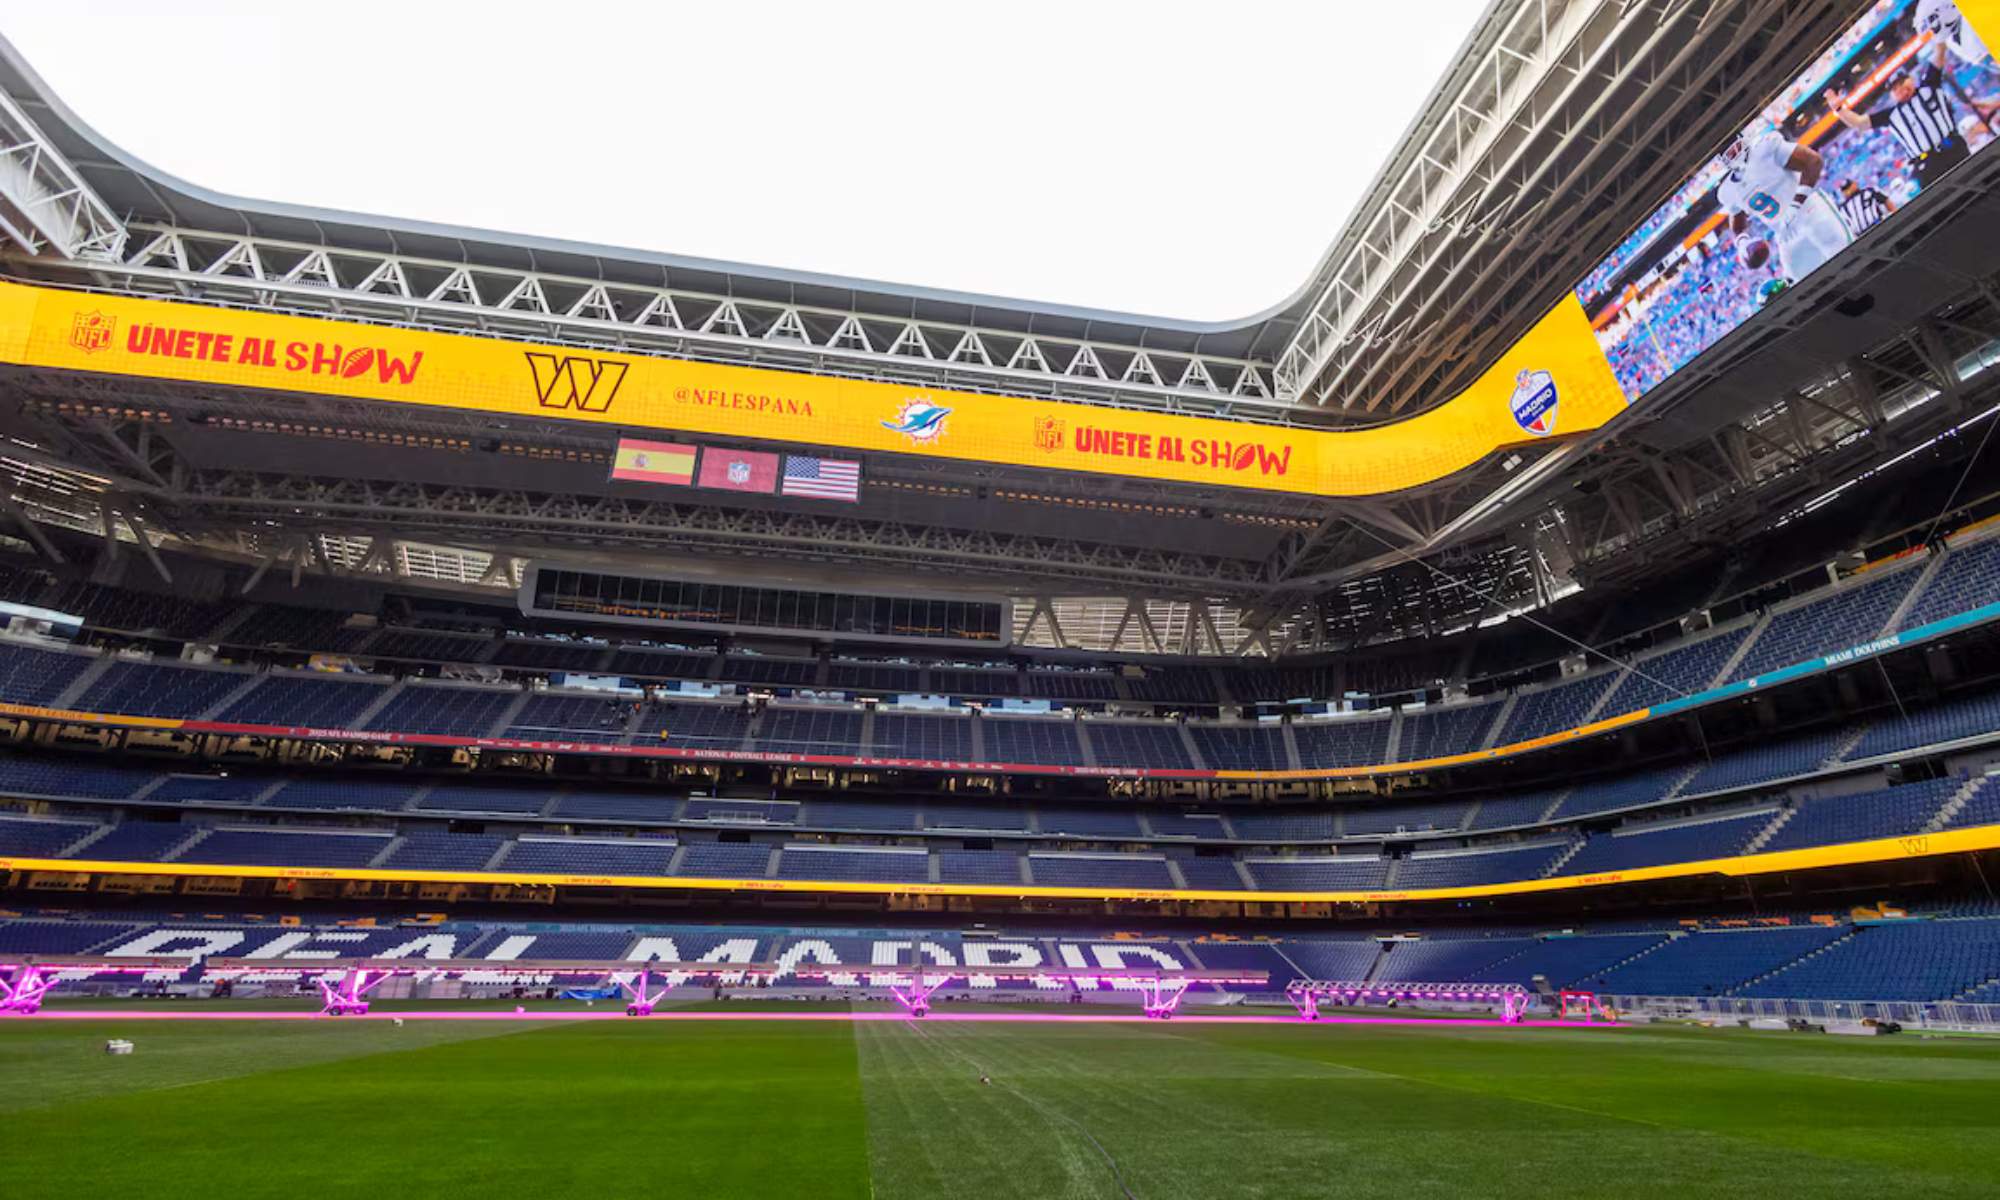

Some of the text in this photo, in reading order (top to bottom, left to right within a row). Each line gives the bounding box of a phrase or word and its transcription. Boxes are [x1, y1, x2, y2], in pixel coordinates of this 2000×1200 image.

[1748, 191, 1780, 219] 9
[238, 337, 276, 367] AL
[285, 341, 424, 385] SHOW
[1518, 388, 1553, 421] MADRID
[1157, 436, 1185, 463] AL
[1190, 439, 1291, 476] SHOW
[1825, 635, 1900, 666] MIAMI DOLPHINS
[694, 750, 793, 762] NATIONAL FOOTBALL LEAGUE
[48, 929, 1188, 992] REAL MADRID
